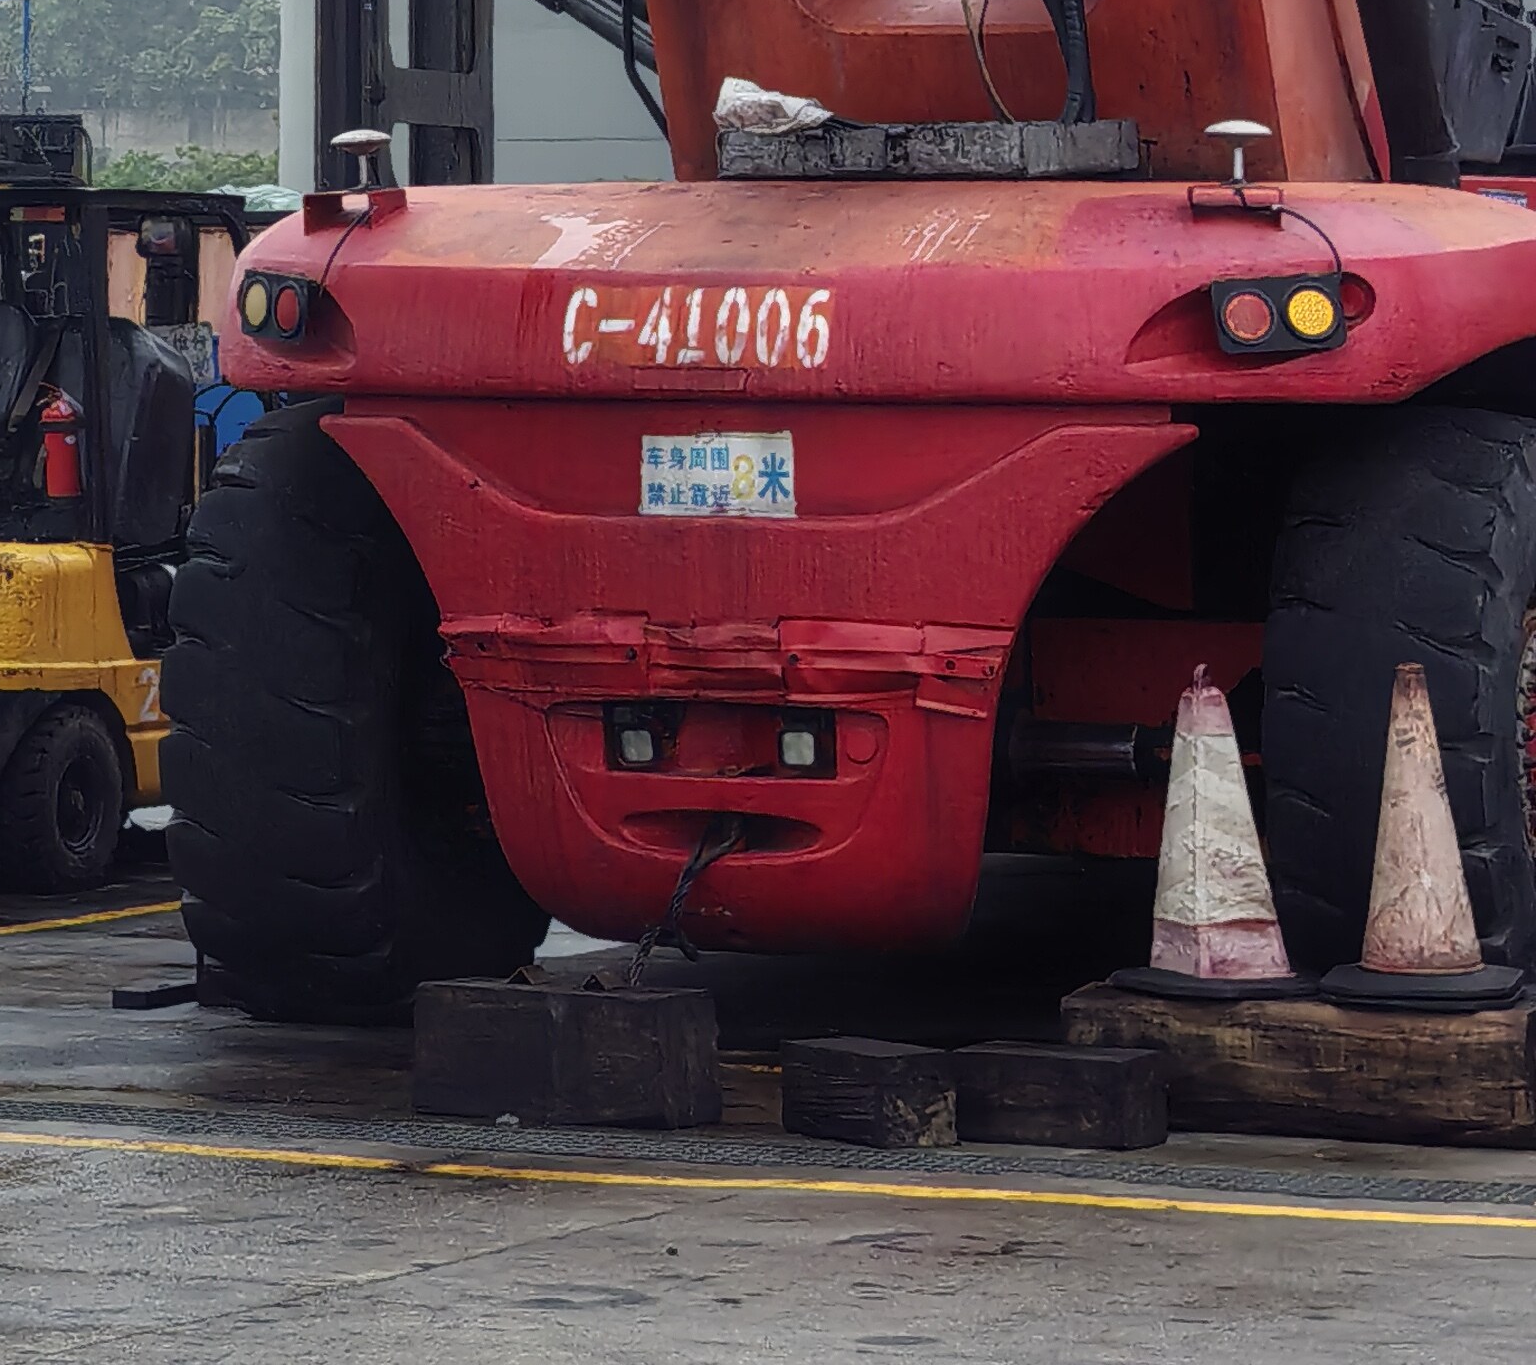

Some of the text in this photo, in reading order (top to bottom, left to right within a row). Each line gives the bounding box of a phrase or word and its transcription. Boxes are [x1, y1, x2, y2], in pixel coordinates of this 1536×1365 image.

[563, 287, 830, 368] C-41006
[646, 445, 730, 470] 车身周围
